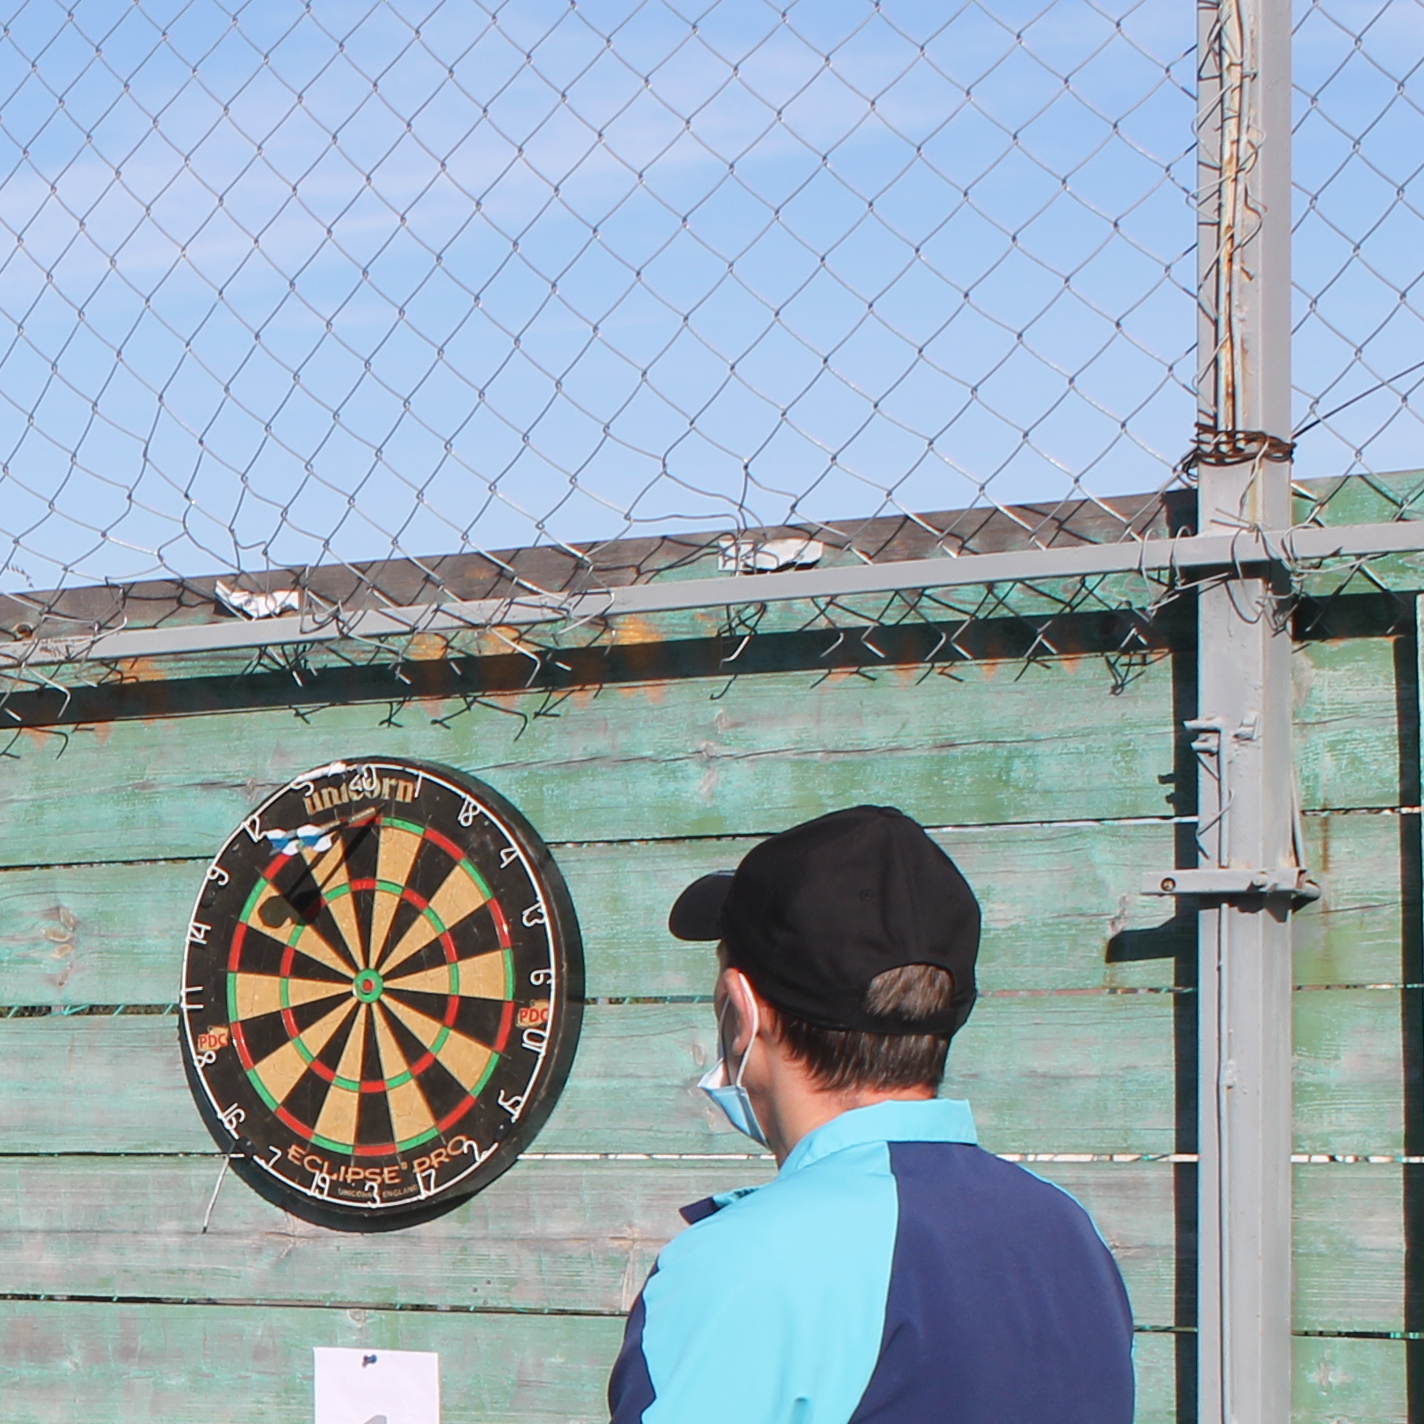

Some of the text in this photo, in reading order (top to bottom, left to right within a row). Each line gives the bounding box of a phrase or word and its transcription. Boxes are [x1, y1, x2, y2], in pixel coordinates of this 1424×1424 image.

[303, 776, 414, 816] unicorn
[413, 771, 423, 798] 1
[458, 795, 481, 827] 18
[207, 864, 230, 886] 9
[187, 922, 212, 945] 14
[180, 986, 204, 1009] 11
[519, 1008, 550, 1023] PDC
[199, 1032, 228, 1048] PDC
[194, 1050, 217, 1069] 8
[268, 1145, 283, 1169] 7
[412, 1135, 468, 1174] PRO
[309, 1171, 331, 1198] 19
[364, 1181, 382, 1208] 3
[416, 1168, 437, 1199] 17
